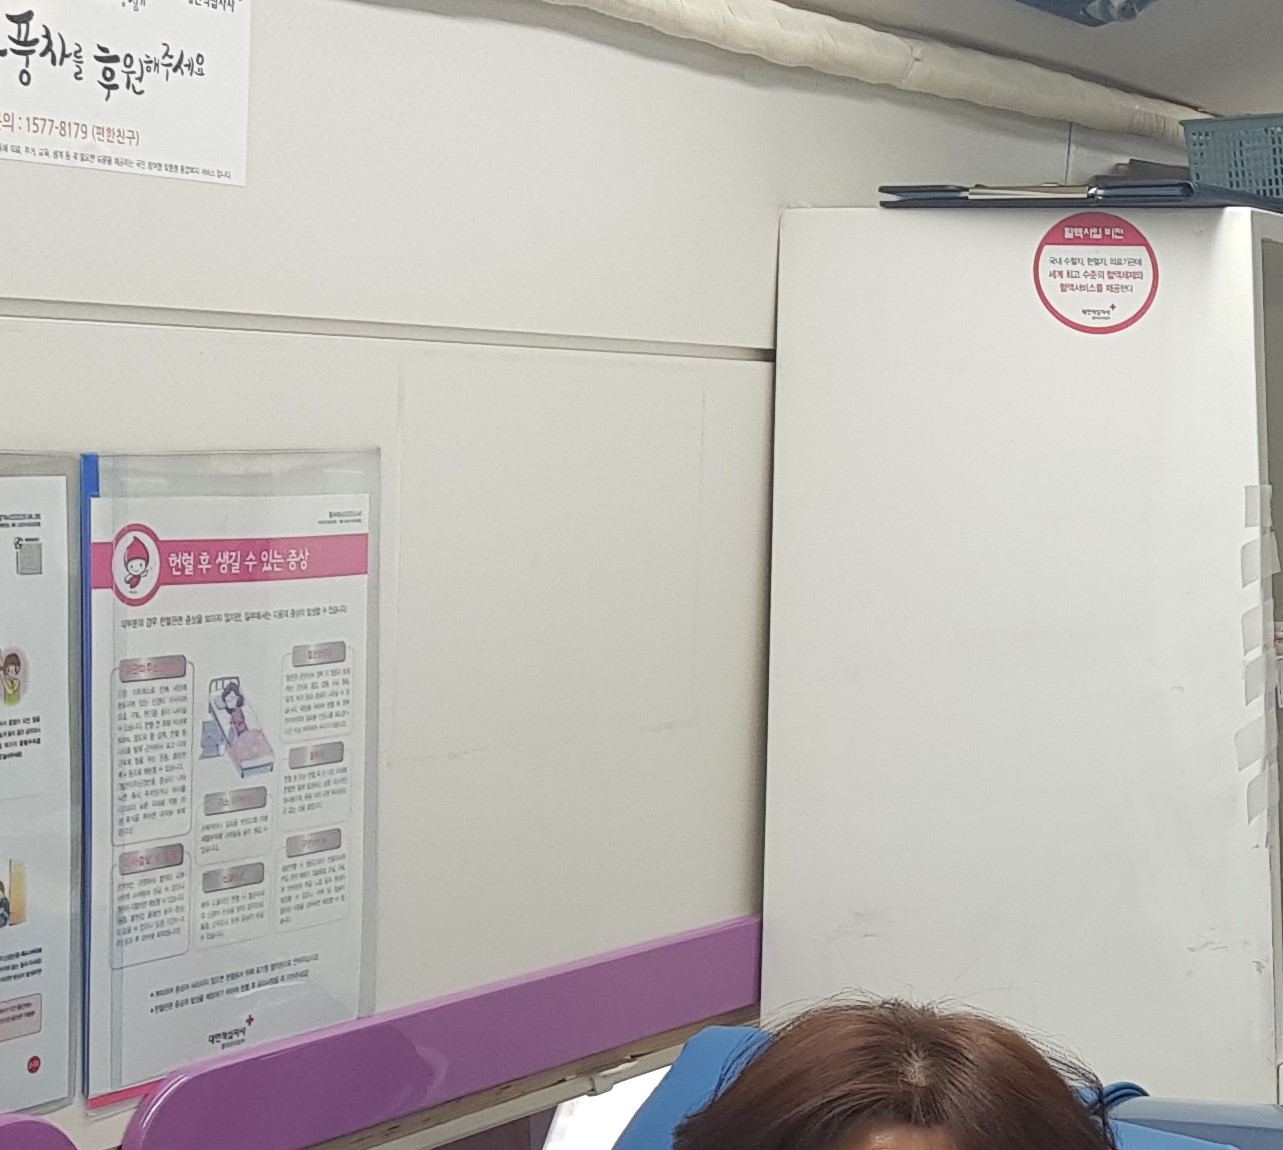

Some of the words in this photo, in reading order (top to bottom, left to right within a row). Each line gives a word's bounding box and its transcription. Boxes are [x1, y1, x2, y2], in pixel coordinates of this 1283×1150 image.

[0, 10, 84, 87] 풍차를
[93, 42, 206, 102] 후원해주세요
[0, 112, 15, 133] 의
[25, 116, 88, 140] 1577-8179
[91, 126, 140, 146] (편한친구)
[1064, 226, 1102, 239] 혈액사업
[1105, 227, 1125, 240] 비전
[168, 552, 194, 576] 헌혈
[198, 553, 210, 574] 후
[216, 552, 240, 576] 생길
[245, 552, 258, 572] 수
[261, 551, 285, 572] 있는
[286, 549, 310, 571] 증상
